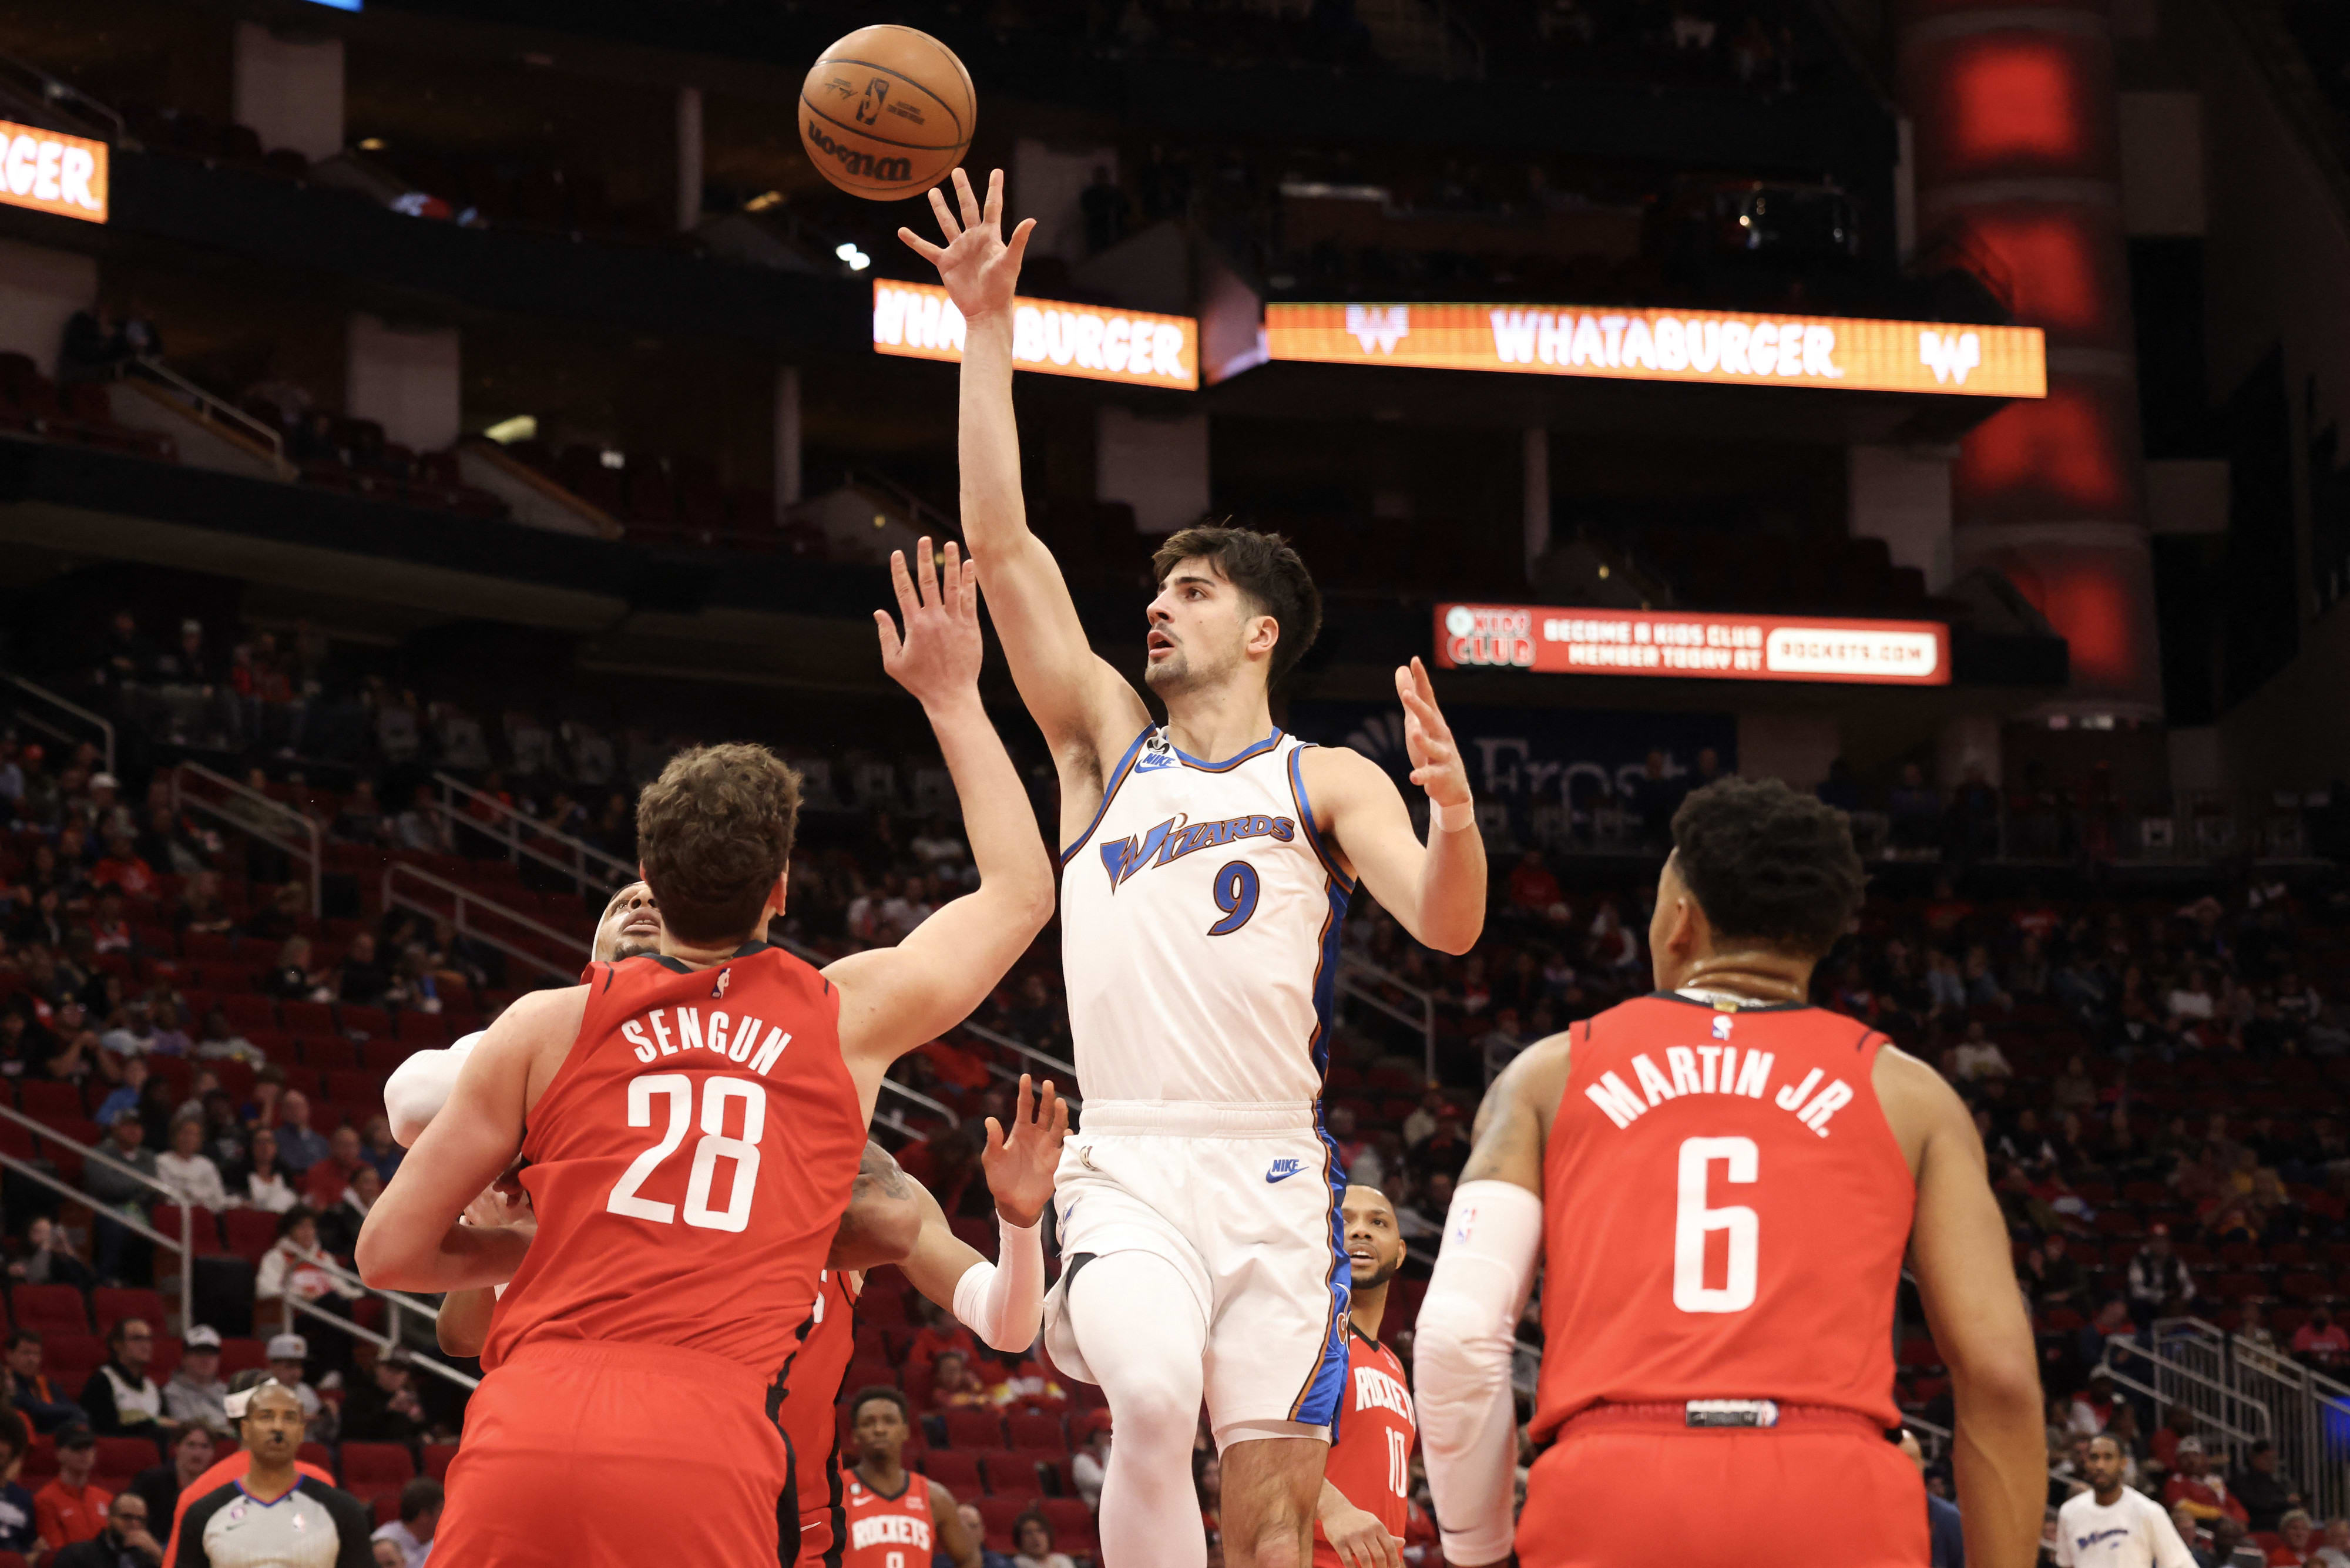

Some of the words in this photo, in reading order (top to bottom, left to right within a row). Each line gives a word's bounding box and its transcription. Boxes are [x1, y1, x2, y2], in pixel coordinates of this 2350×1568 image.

[874, 287, 1190, 379] WHABURGER
[1490, 309, 1842, 378] WHATABURGER
[1543, 619, 1631, 643] BECOME
[1653, 623, 1704, 646] KIDS
[1706, 624, 1762, 649] CLUB
[1780, 641, 1922, 662] ROCKETS.COM
[1142, 753, 1176, 767] NIKE
[1206, 860, 1260, 936] 9
[621, 1007, 793, 1076] SENGUN
[1585, 1046, 1775, 1130] MARTIN
[1775, 1067, 1854, 1139] JR.
[606, 1074, 766, 1233] 28
[1271, 1159, 1300, 1173] NIKE
[1673, 1136, 1759, 1313] 6
[1385, 1426, 1408, 1498] 10
[852, 1514, 931, 1550] ROCKETS
